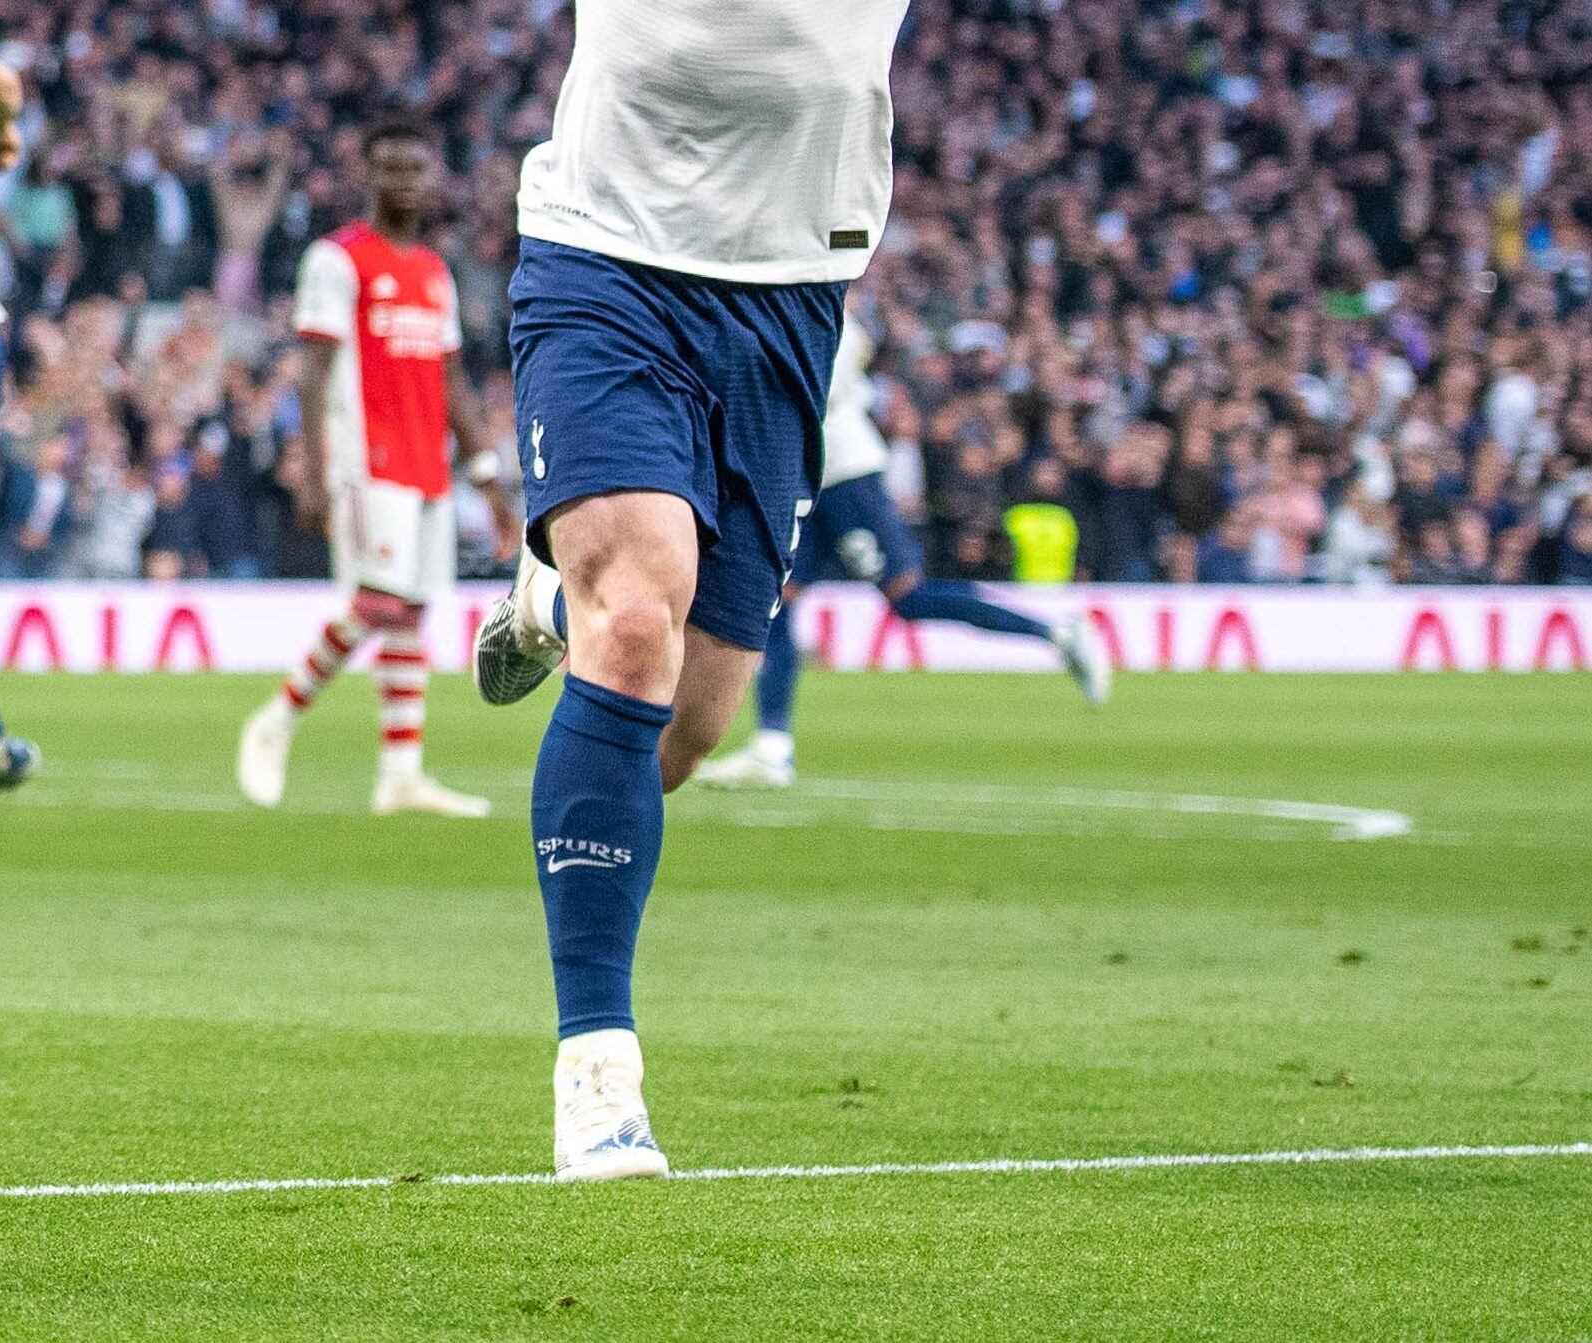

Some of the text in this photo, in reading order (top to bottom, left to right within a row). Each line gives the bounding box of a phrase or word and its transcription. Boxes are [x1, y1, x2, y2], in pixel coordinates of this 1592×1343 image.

[2, 601, 215, 667] AIA
[1399, 605, 1588, 666] AIA
[537, 837, 633, 865] SPURS
